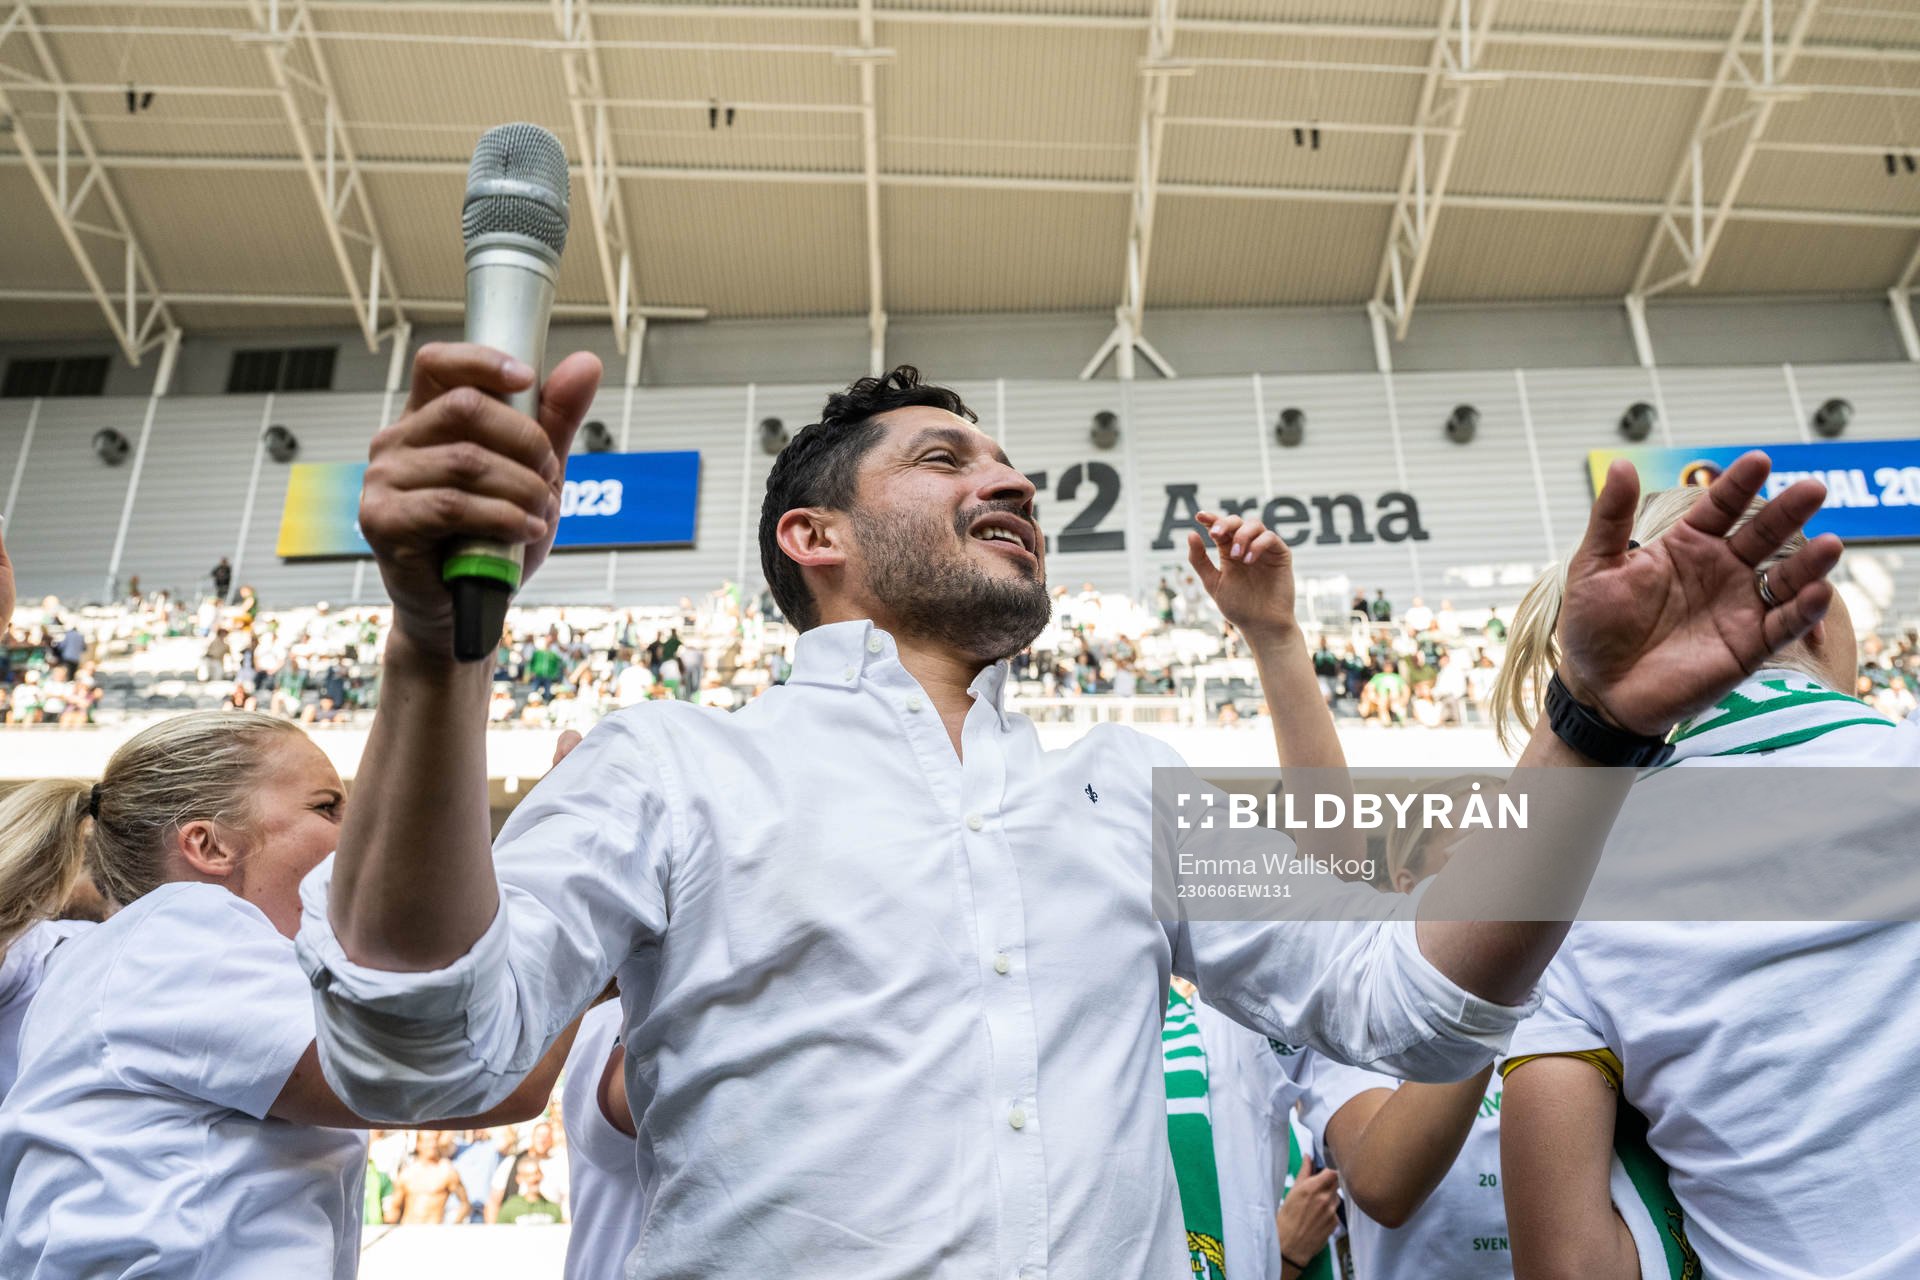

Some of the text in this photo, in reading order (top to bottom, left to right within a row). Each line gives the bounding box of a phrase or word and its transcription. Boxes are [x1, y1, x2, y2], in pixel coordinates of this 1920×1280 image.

[1767, 469, 1879, 508] FAL
[1478, 1173, 1498, 1187] 20
[1473, 1237, 1508, 1251] SVEN
